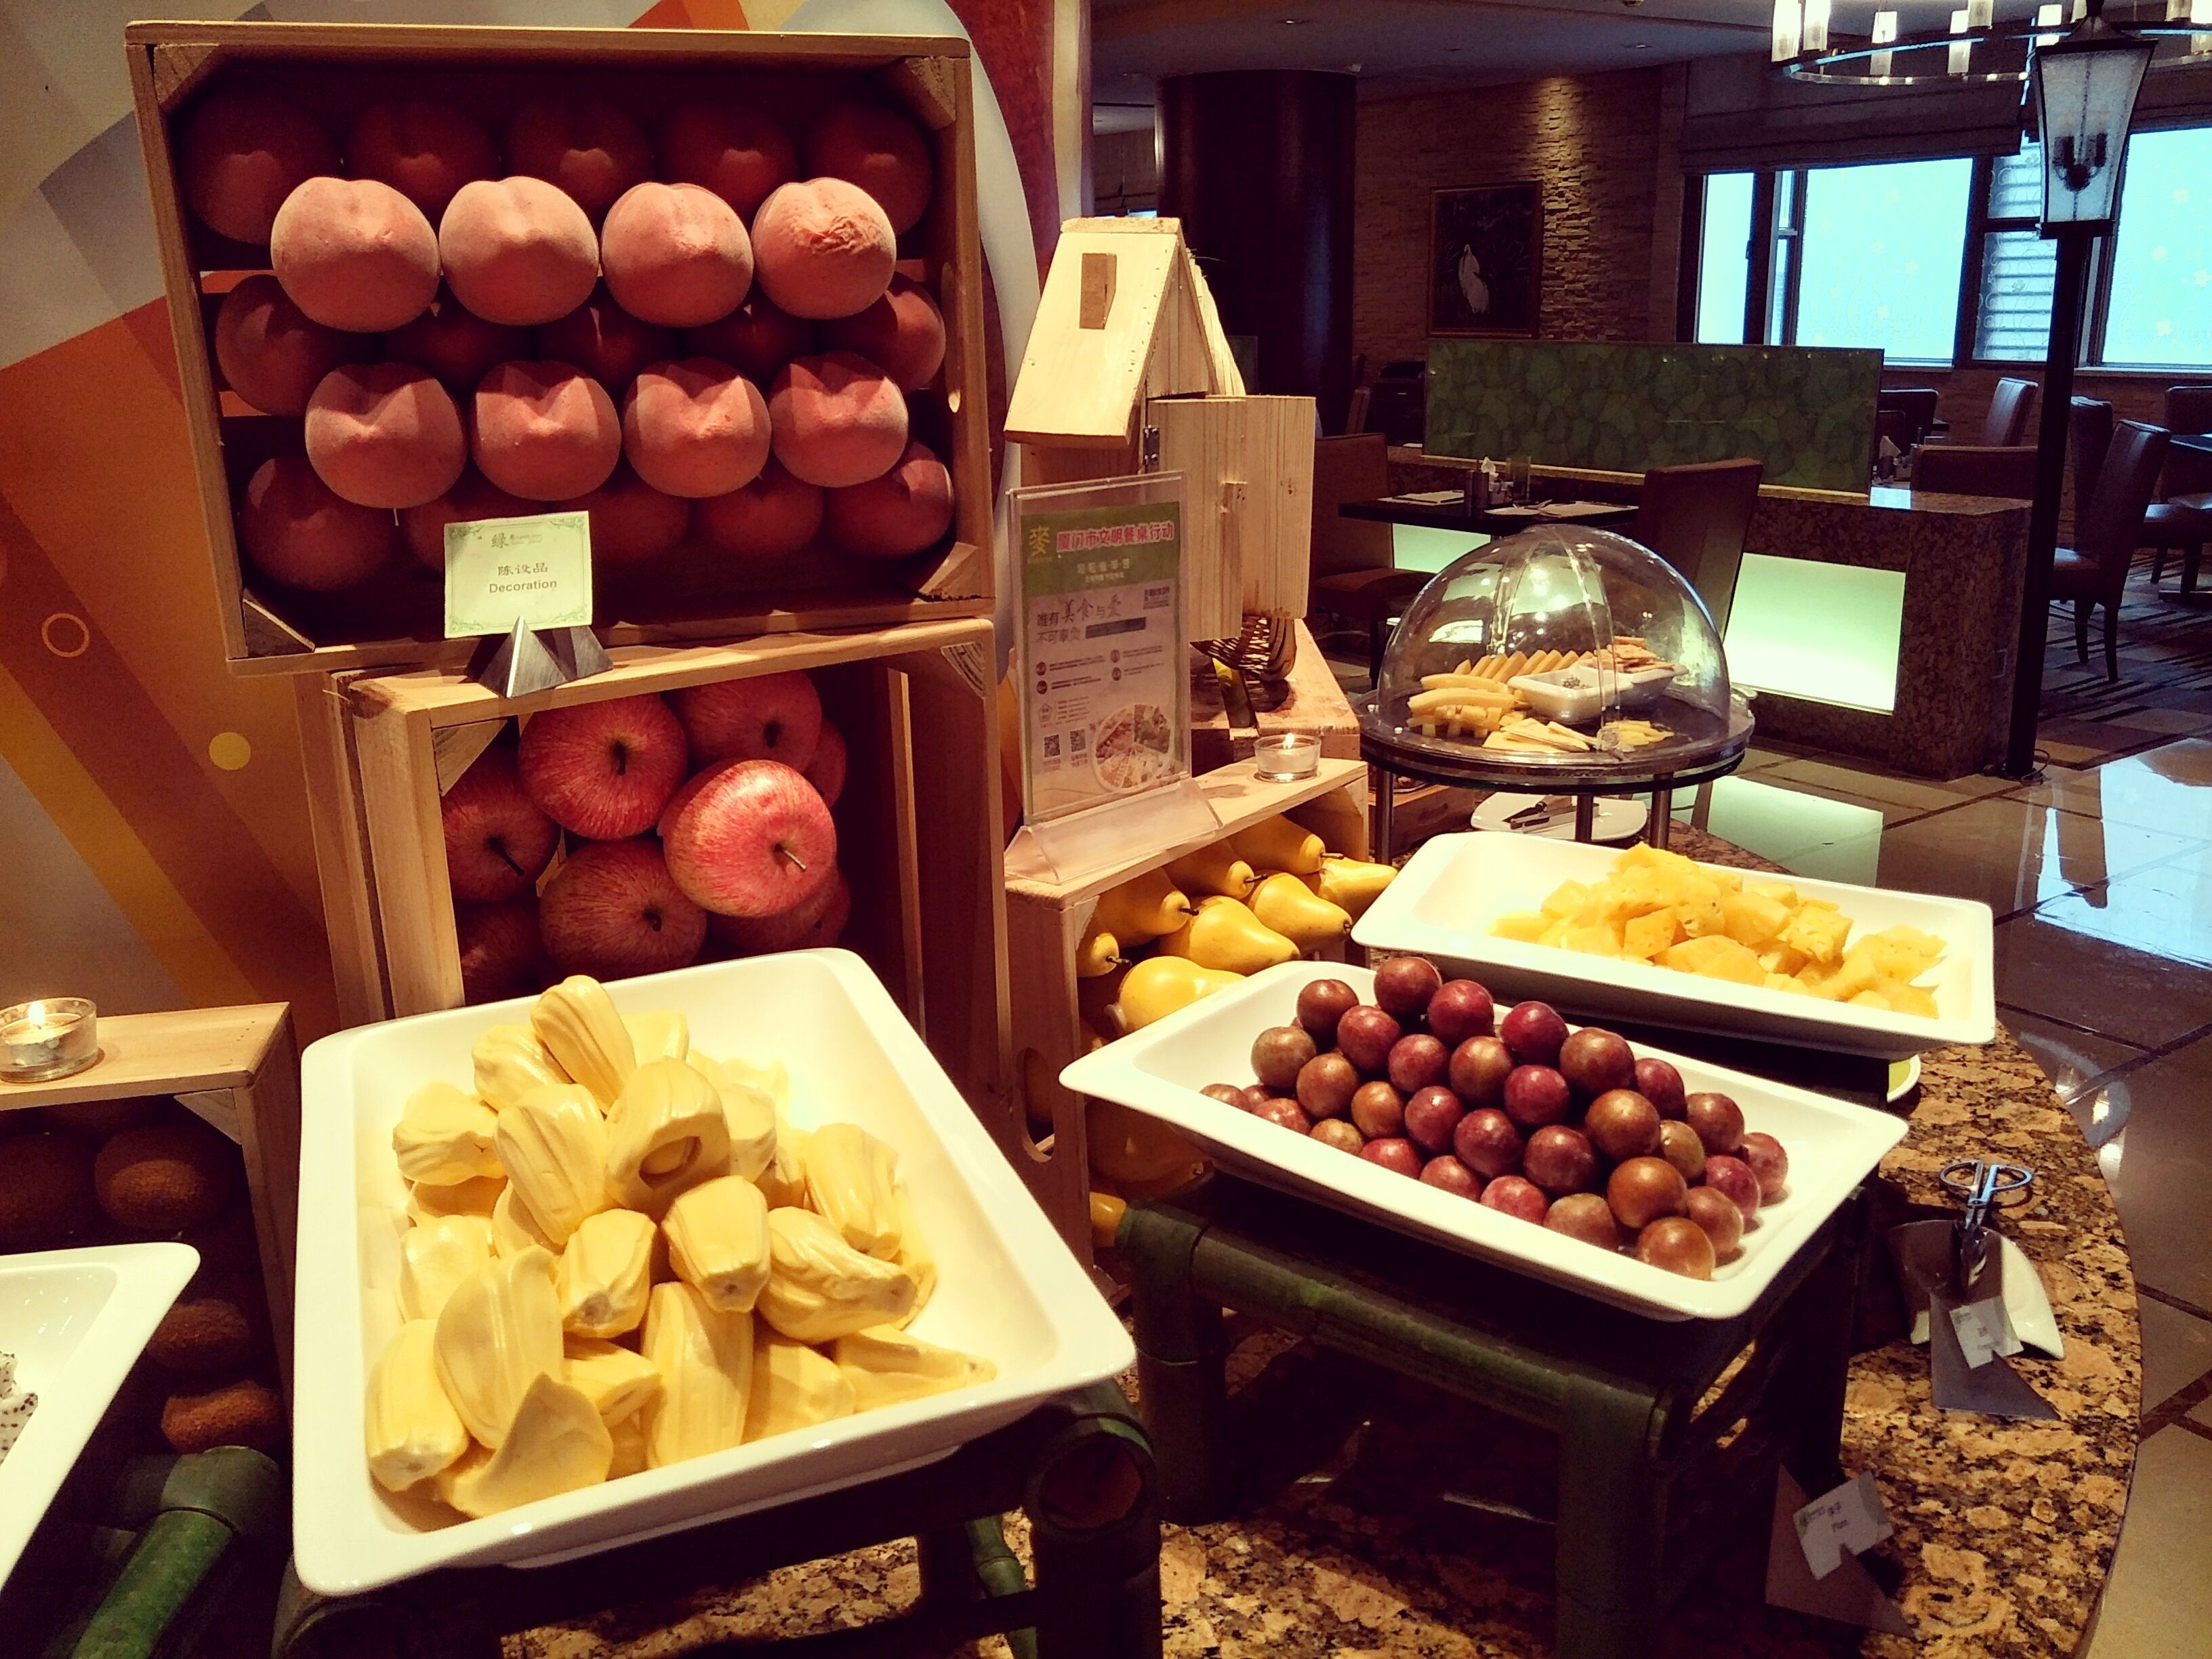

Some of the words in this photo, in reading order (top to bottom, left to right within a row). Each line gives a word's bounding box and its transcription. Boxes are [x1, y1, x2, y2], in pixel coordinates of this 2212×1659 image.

[1057, 520, 1174, 552] 厦门市文明餐桌行动
[497, 562, 548, 577] 陈设品
[489, 579, 557, 594] Decoration
[1037, 594, 1122, 627] 唯有美食与爱
[1036, 626, 1080, 644] 不可辜负
